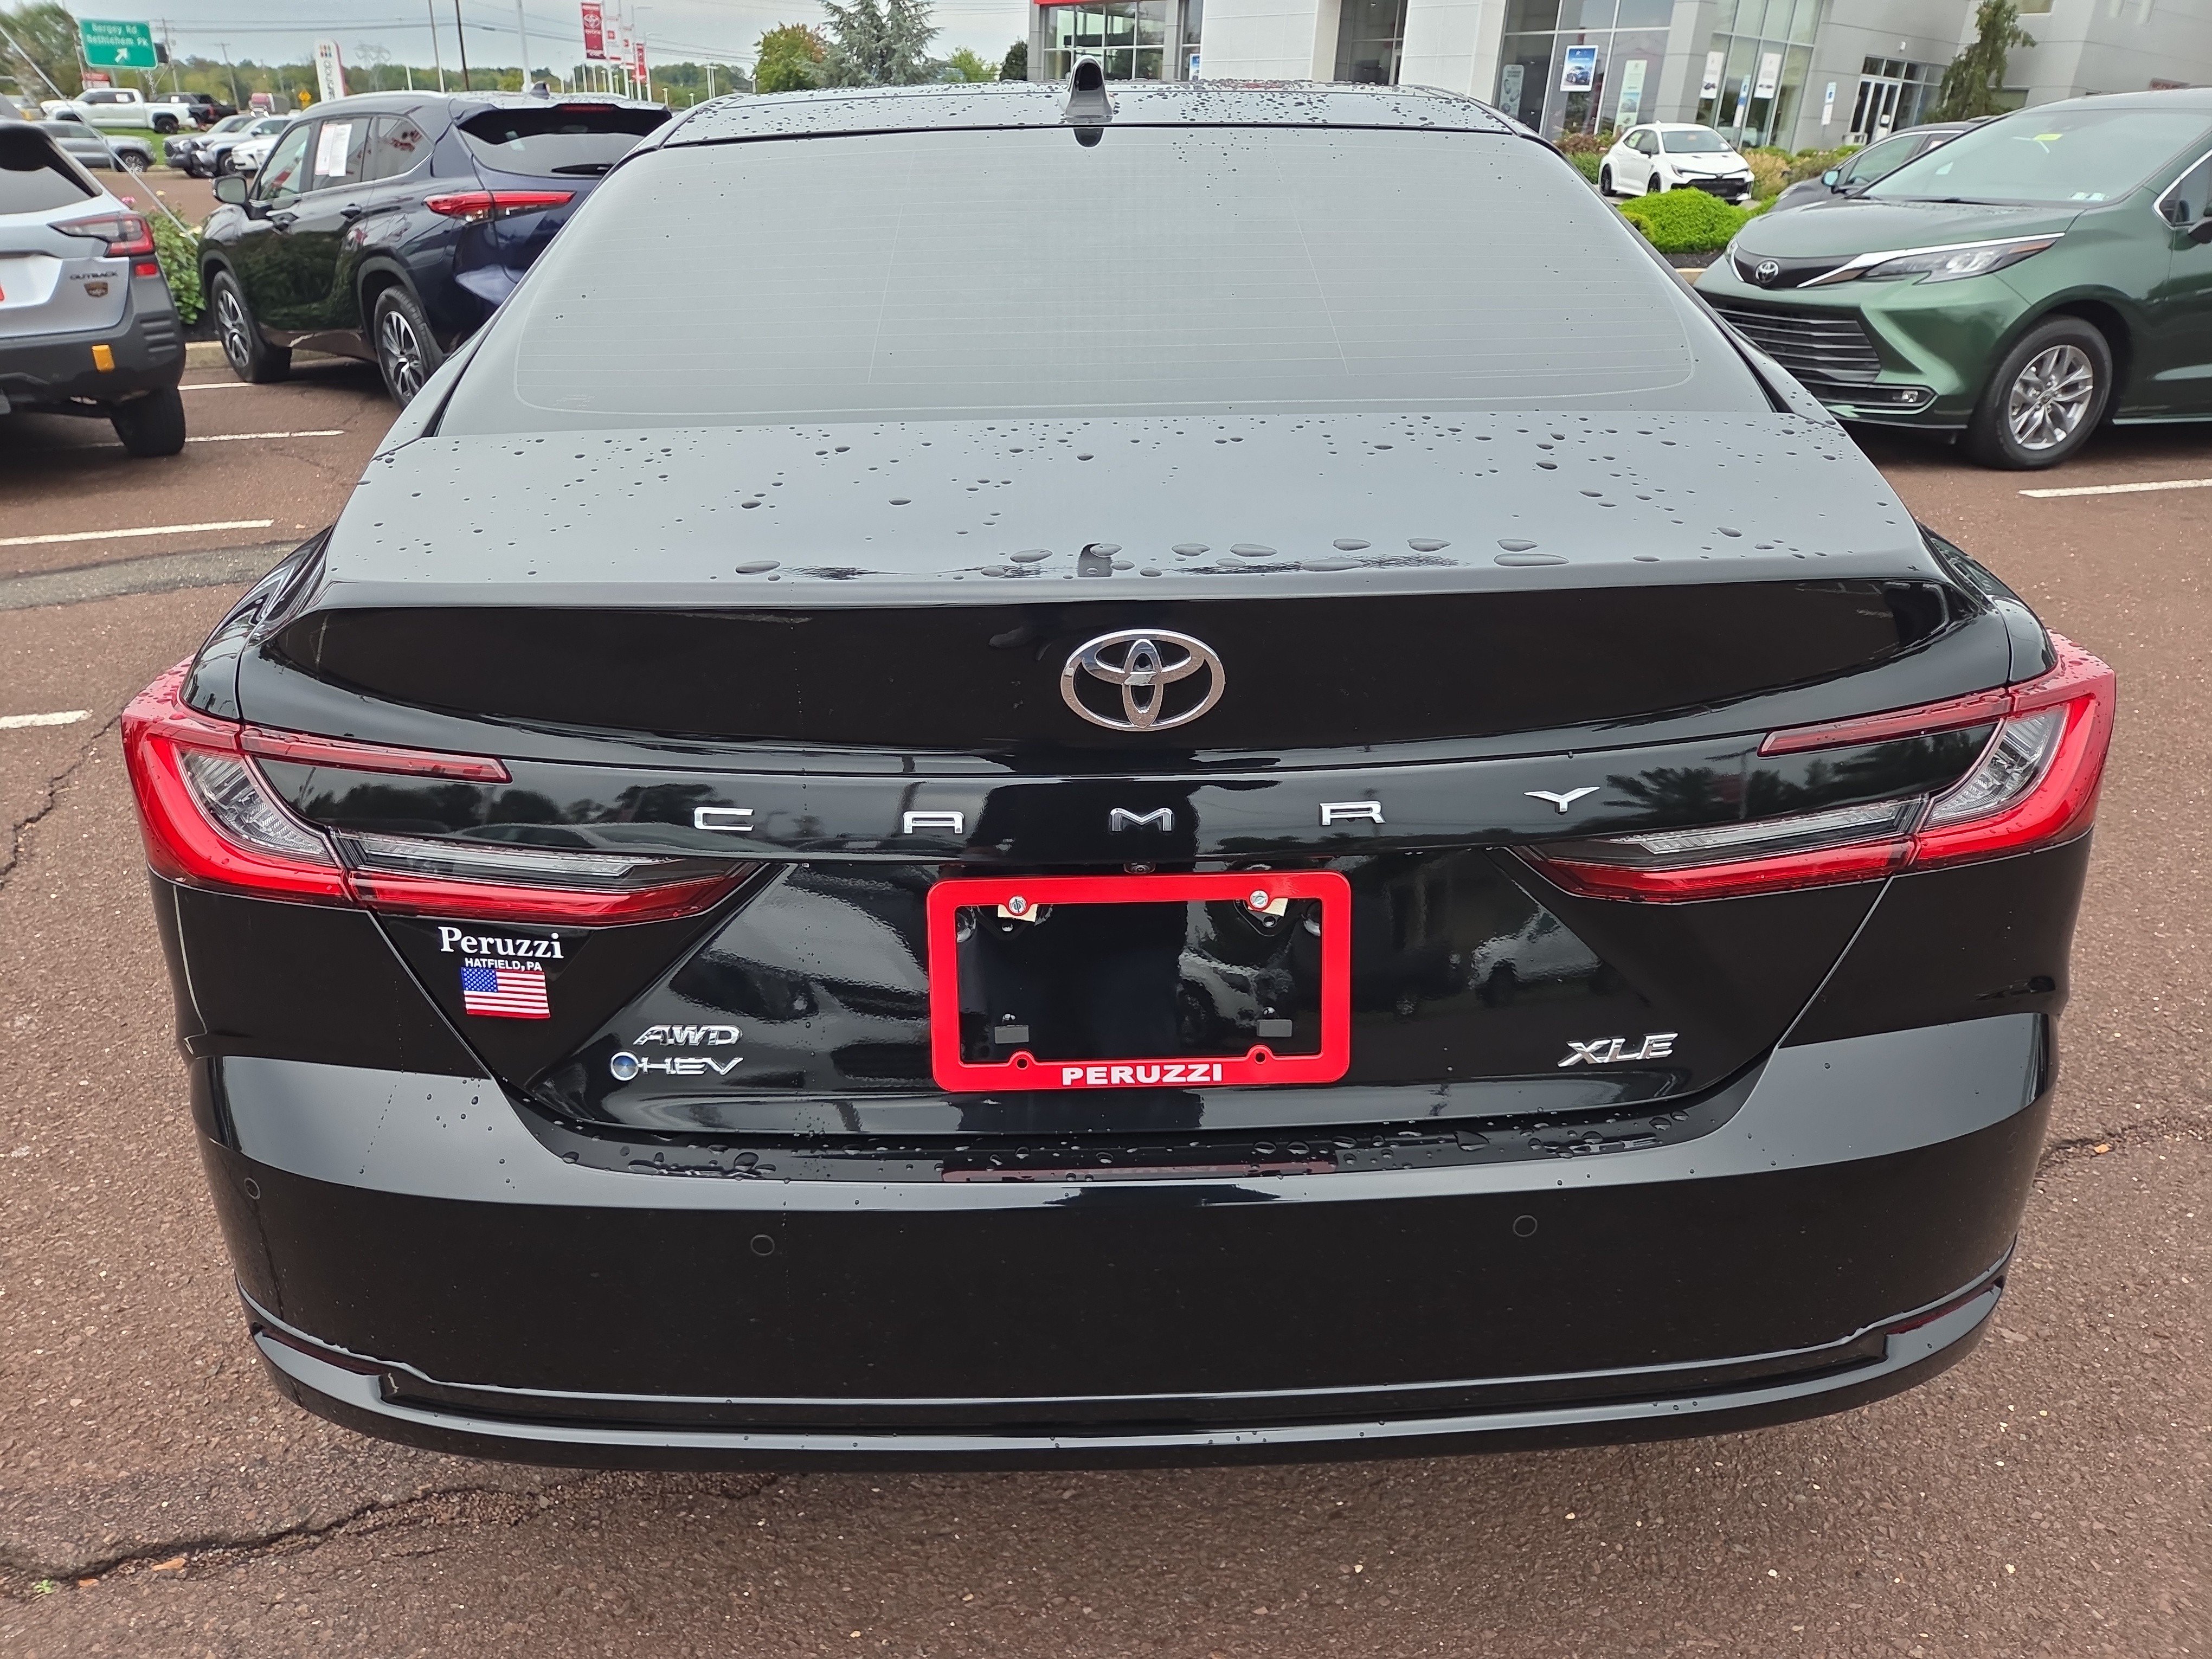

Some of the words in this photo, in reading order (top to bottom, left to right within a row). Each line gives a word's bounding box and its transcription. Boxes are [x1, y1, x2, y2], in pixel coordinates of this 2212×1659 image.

[694, 787, 1600, 835] CAMRY
[438, 926, 564, 959] Peruzzi
[465, 957, 525, 972] HATFIELD,
[526, 961, 543, 972] PA
[632, 1024, 743, 1046] AWD
[1557, 1032, 1679, 1068] XLE
[640, 1057, 744, 1076] HEV
[1062, 1063, 1223, 1085] PERUZZI
